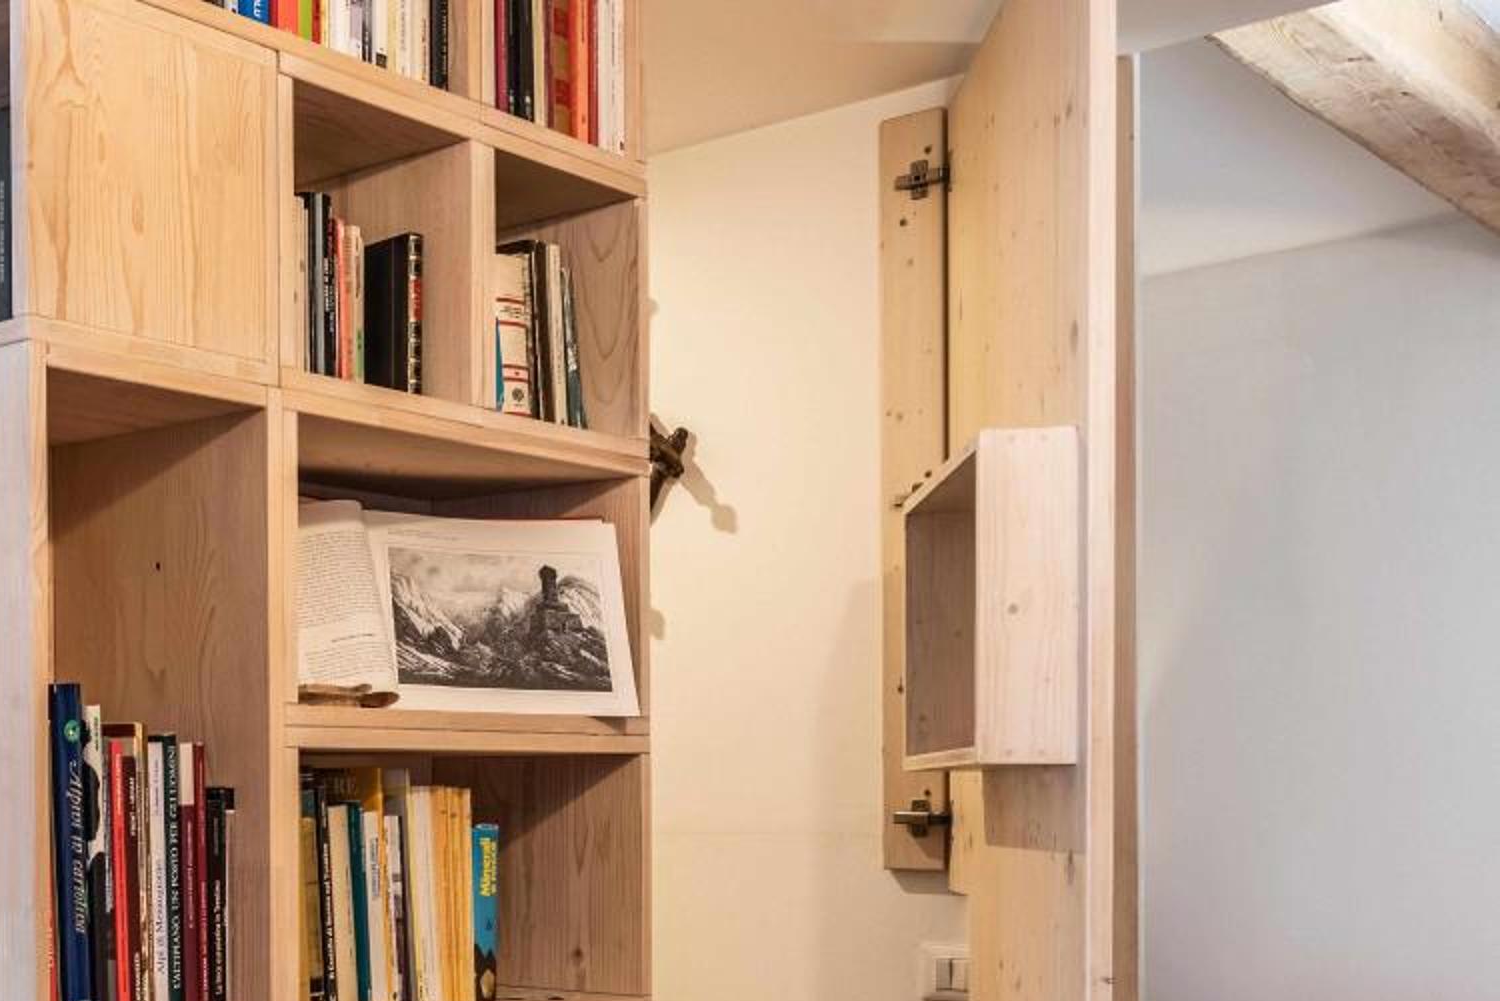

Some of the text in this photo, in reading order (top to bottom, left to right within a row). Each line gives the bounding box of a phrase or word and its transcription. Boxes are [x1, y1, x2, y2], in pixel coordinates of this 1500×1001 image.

[167, 744, 177, 796] UOMINI
[67, 762, 87, 934] Alpini in cartolina
[479, 837, 491, 897] Minerali
